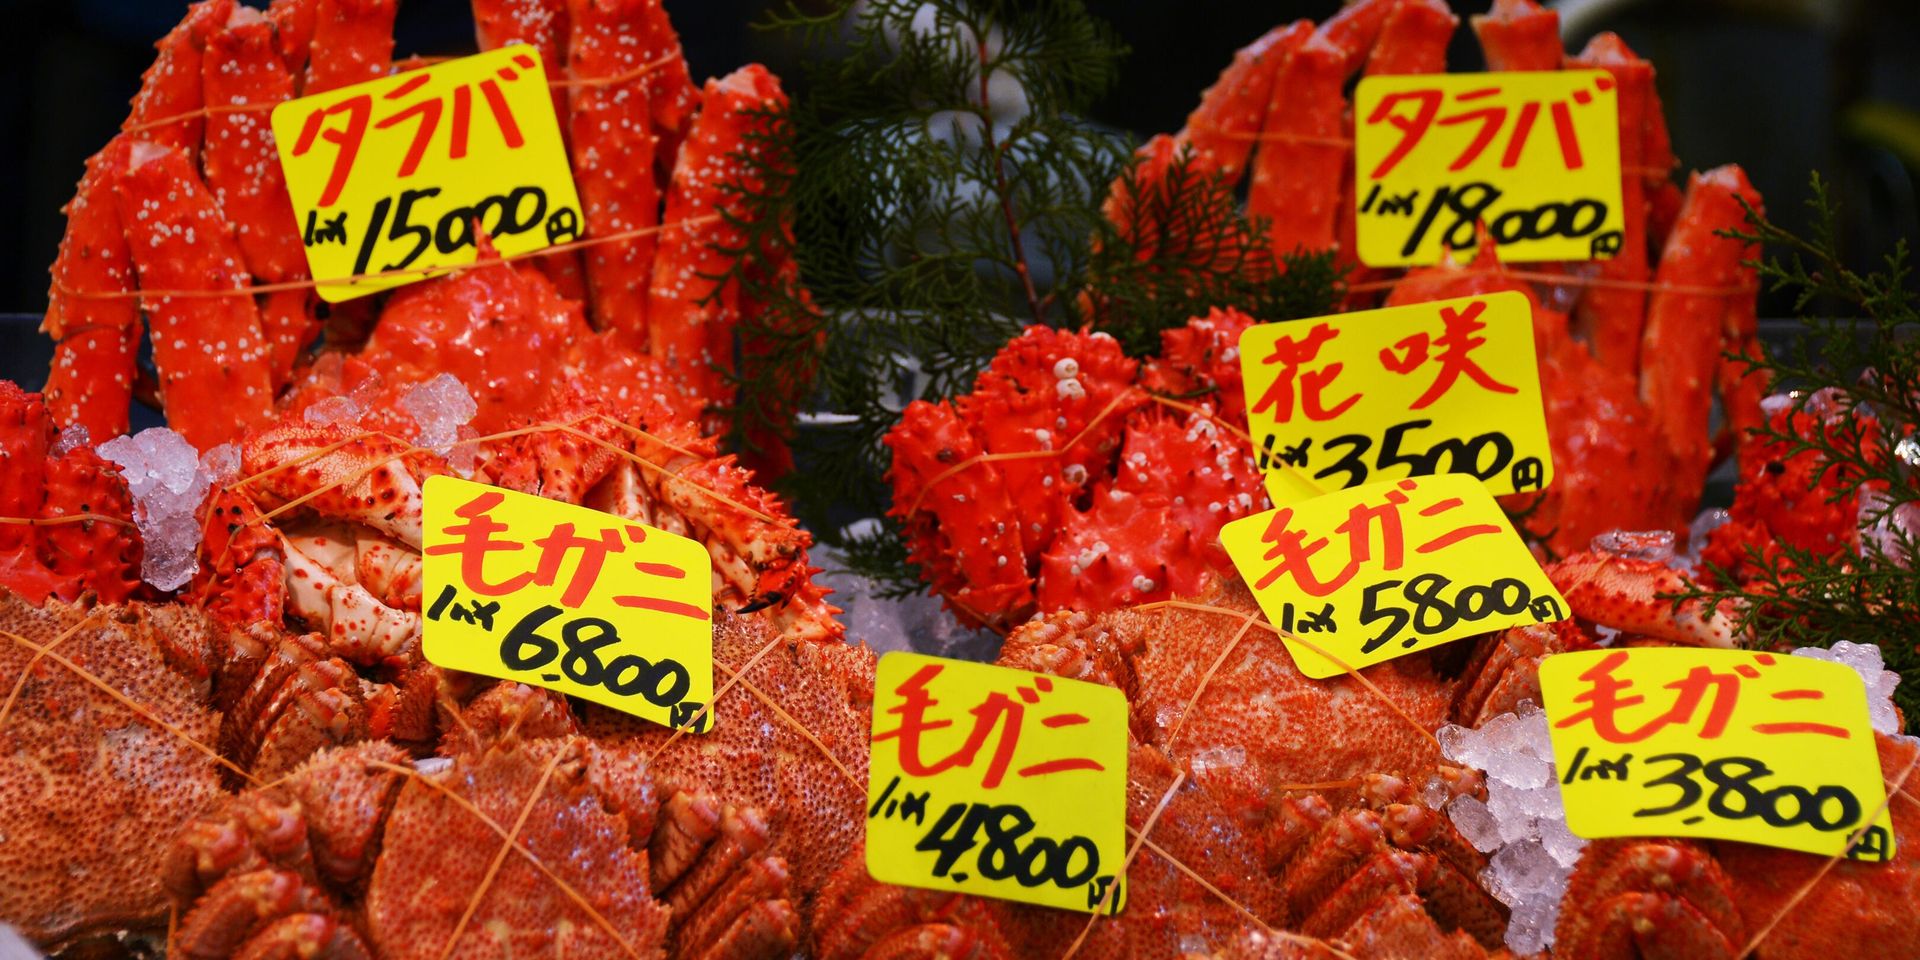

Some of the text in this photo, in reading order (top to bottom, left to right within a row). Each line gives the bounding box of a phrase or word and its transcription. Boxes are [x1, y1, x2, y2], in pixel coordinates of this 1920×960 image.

[292, 54, 536, 208] タラバ
[1366, 77, 1616, 179] タラバ
[1251, 301, 1519, 423] 花咲
[424, 492, 711, 620] 毛ガニ
[1255, 479, 1502, 597] 毛ガニ
[872, 664, 1105, 789] 毛ガニ
[1554, 651, 1851, 744] 毛ガニ
